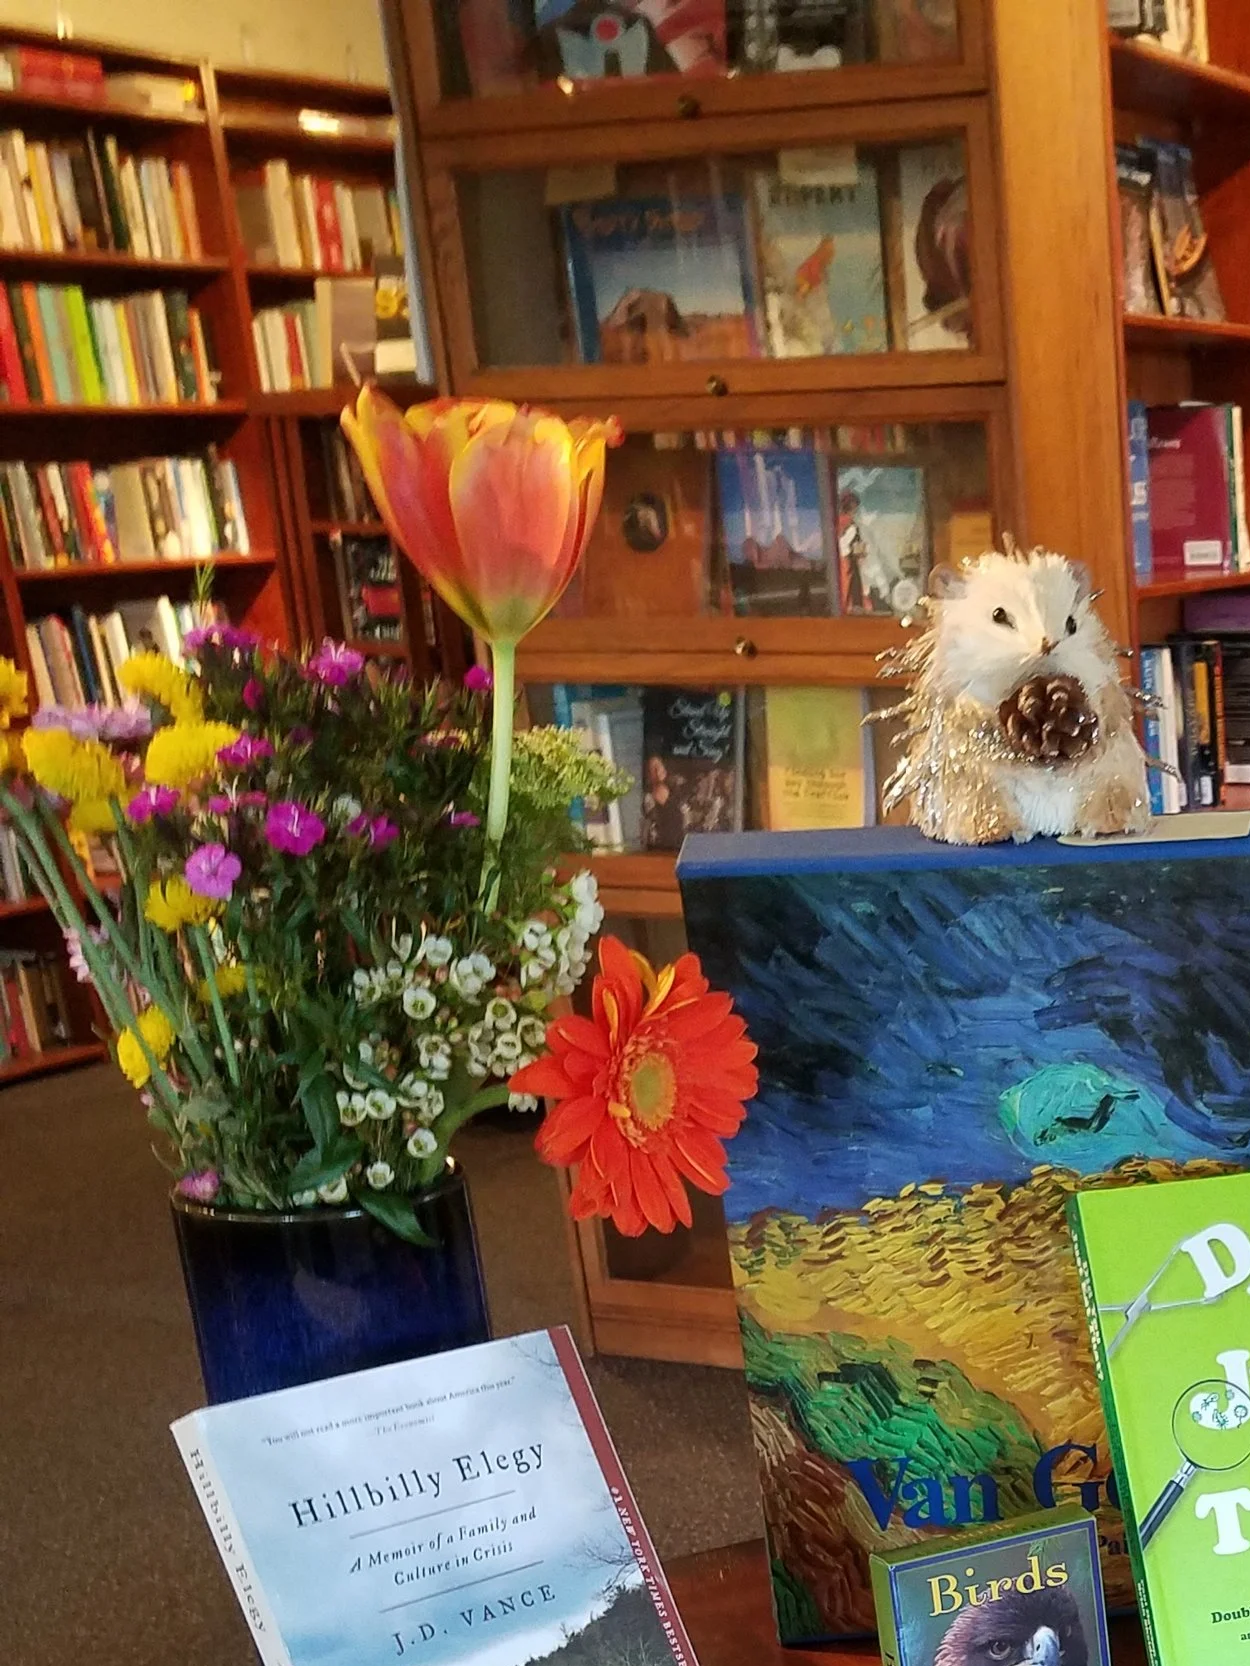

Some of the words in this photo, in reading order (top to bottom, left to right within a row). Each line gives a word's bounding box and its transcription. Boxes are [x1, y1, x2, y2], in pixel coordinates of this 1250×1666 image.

[190, 1448, 236, 1555] Hillbilly
[288, 1469, 442, 1528] Hillbilly
[452, 1440, 546, 1482] Elegy
[843, 1456, 1004, 1532] Van
[350, 1557, 362, 1574] A
[368, 1542, 424, 1569] Memoir
[429, 1533, 443, 1551] of
[446, 1534, 454, 1544] a
[458, 1516, 508, 1542] Family
[512, 1506, 537, 1525] and
[394, 1560, 450, 1586] Culture
[455, 1554, 470, 1568] in
[473, 1541, 513, 1562] Crisis
[617, 1506, 636, 1536] NEW
[631, 1540, 650, 1575] YORK
[645, 1575, 667, 1618] TIMES
[392, 1622, 449, 1657] J.D.
[460, 1584, 556, 1628] VANCE
[926, 1555, 1069, 1617] Birds
